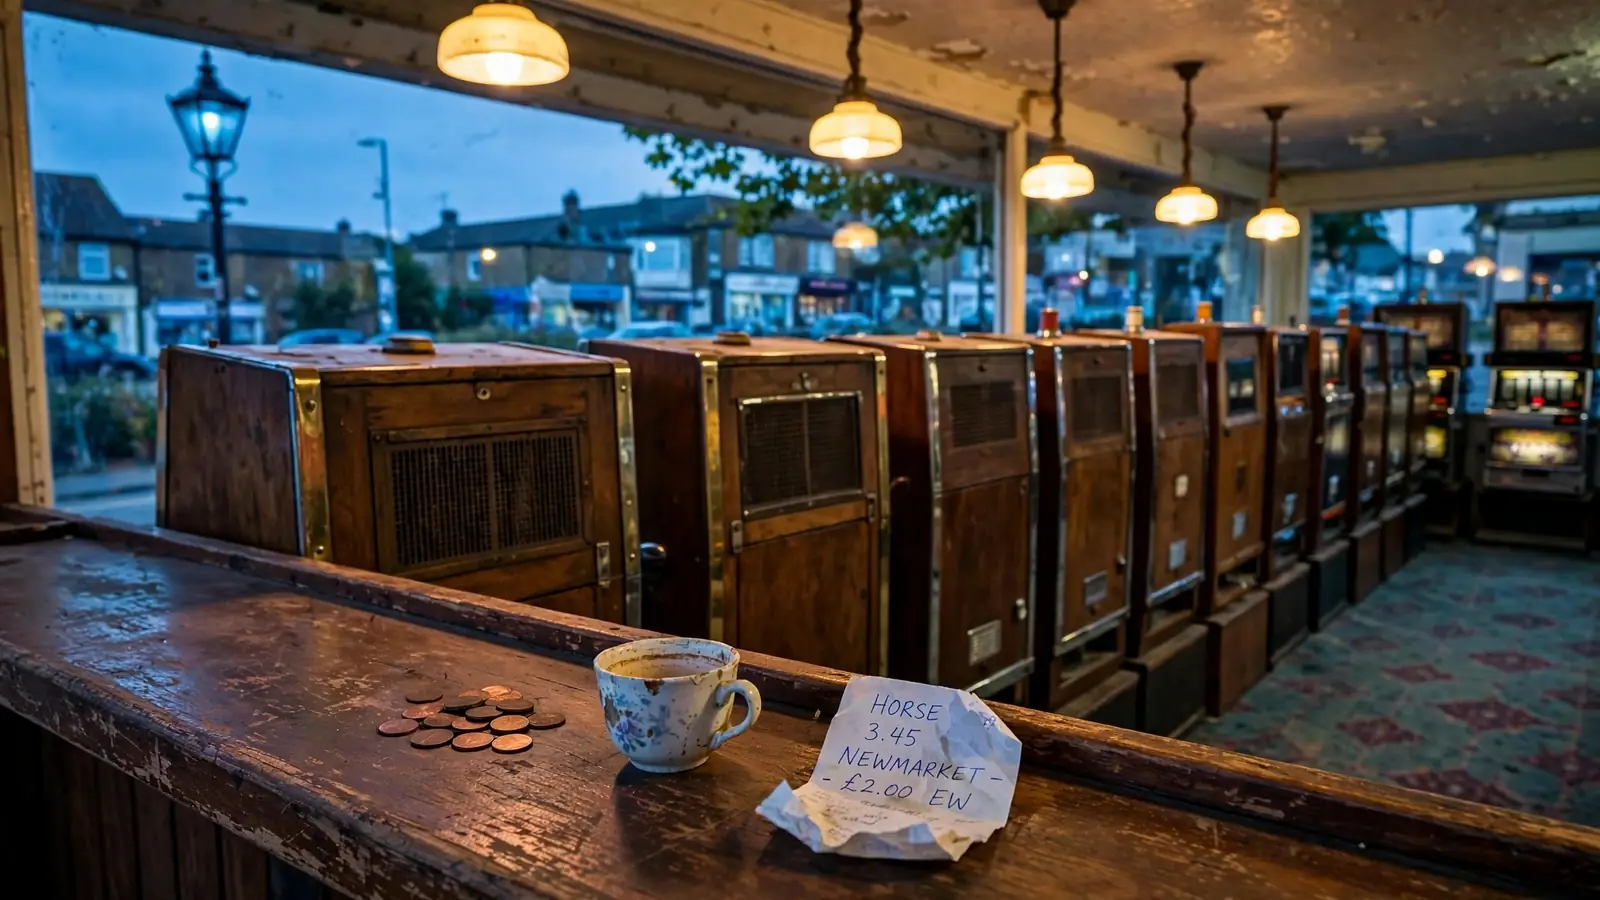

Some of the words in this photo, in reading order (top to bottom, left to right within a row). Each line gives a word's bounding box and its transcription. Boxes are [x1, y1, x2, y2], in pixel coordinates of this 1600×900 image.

[870, 693, 943, 721] HORSE
[864, 722, 921, 747] 3.45
[838, 746, 985, 784] NEWMARKET
[840, 773, 913, 799] £2.00
[928, 789, 973, 811] EW
